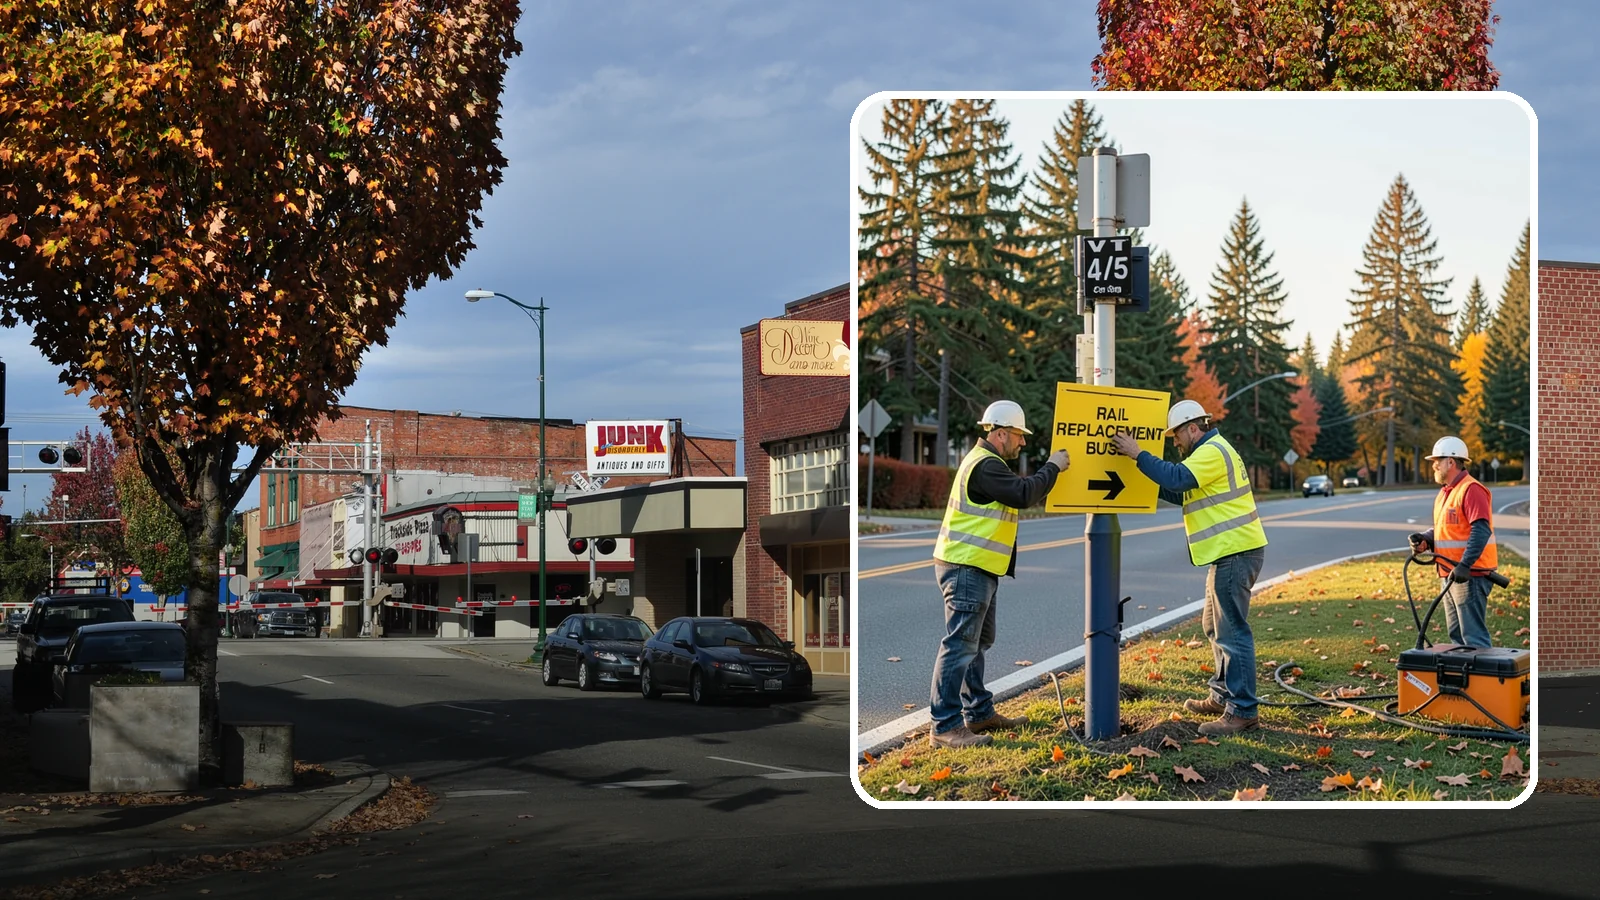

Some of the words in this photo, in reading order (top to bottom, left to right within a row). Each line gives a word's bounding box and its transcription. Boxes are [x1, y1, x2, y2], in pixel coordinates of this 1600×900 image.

[1087, 256, 1128, 281] 4/5
[1096, 406, 1129, 421] RAIL
[1056, 422, 1165, 441] REPLACEMENT
[595, 425, 665, 457] JUNK
[1086, 441, 1128, 456] BUS
[607, 446, 645, 454] DISORDERLY
[596, 461, 627, 470] ANTIQUES
[631, 461, 643, 470] AND
[646, 460, 665, 469] GIFTS
